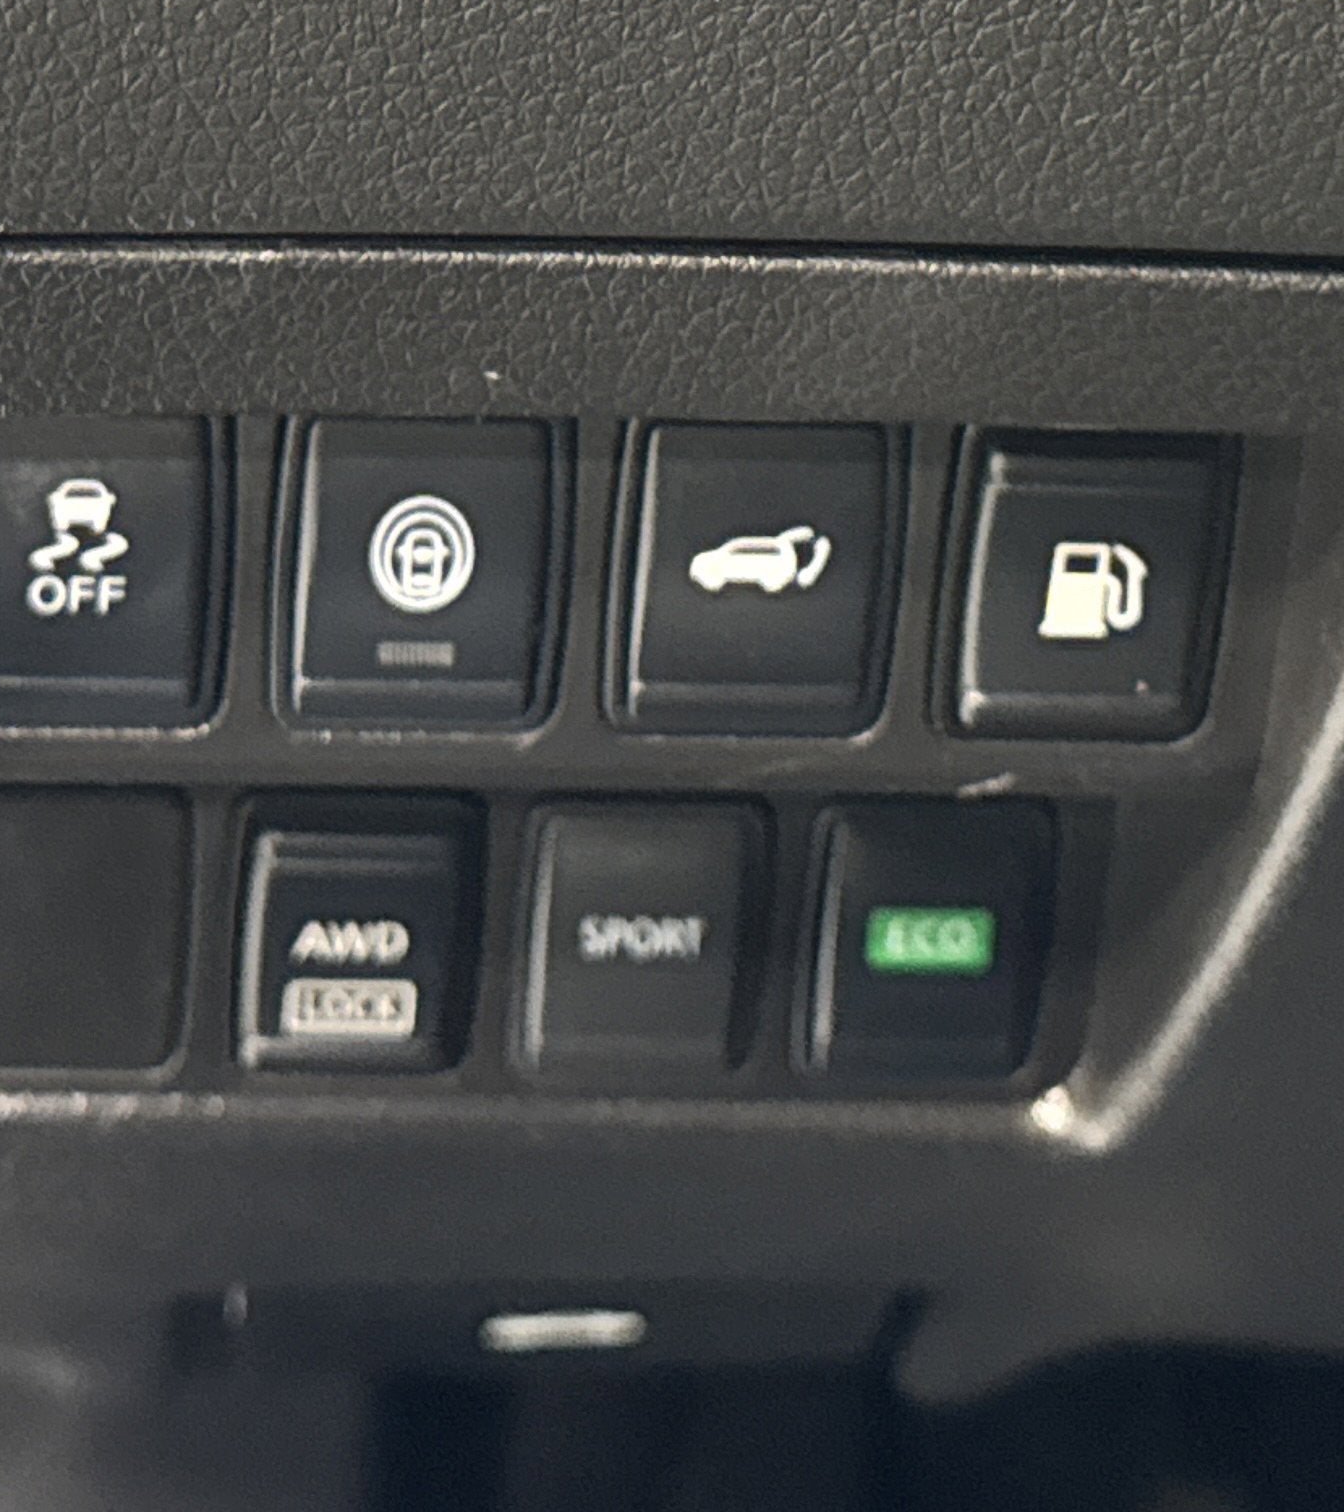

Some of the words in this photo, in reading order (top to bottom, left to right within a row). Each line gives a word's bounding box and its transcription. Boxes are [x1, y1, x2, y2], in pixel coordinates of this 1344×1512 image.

[27, 575, 126, 615] OFF
[290, 920, 410, 965] AWD
[579, 915, 706, 962] SPORT
[884, 914, 978, 962] ECO
[295, 986, 406, 1023] LOCK
